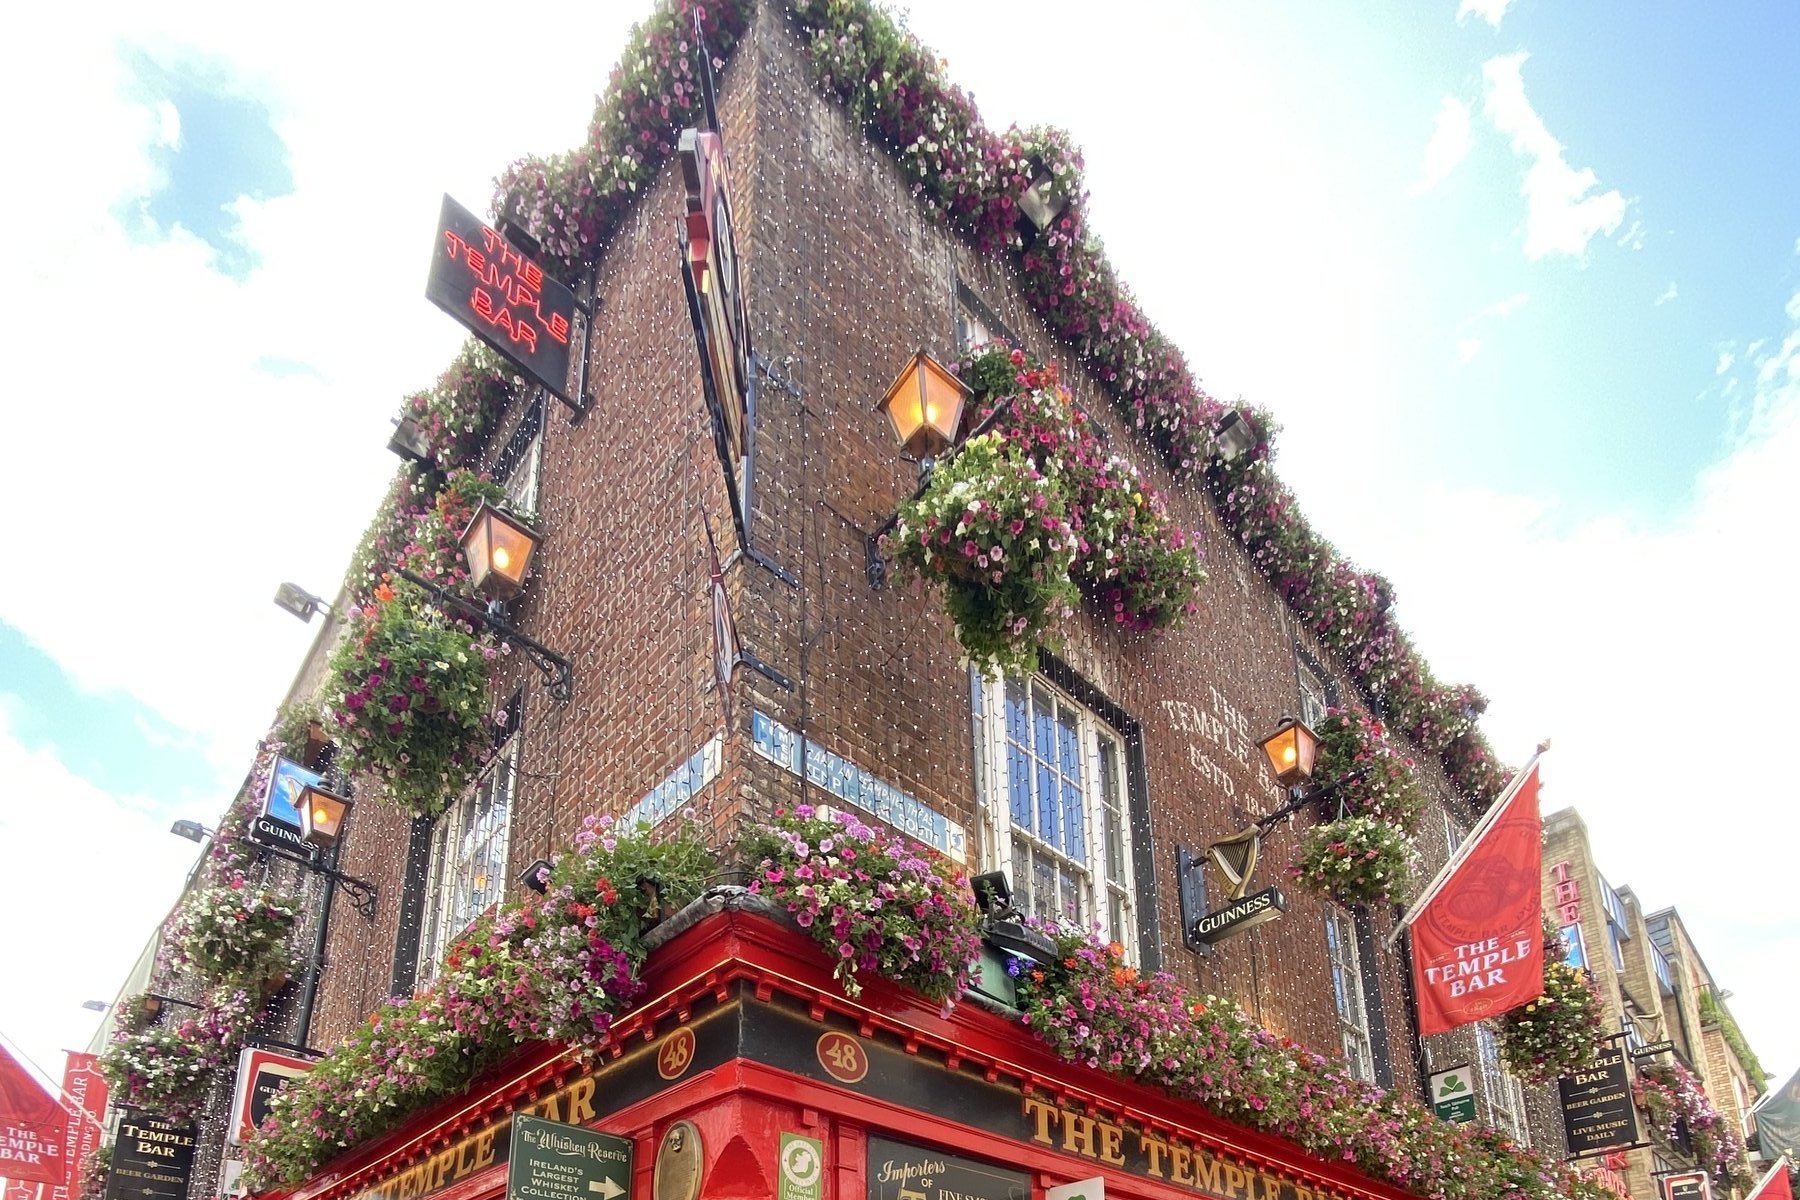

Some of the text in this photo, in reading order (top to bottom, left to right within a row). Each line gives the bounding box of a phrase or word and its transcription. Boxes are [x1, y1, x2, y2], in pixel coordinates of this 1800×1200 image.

[483, 225, 543, 292] THE
[444, 230, 569, 344] TEMPLE
[471, 287, 537, 353] BAR
[1199, 893, 1270, 934] GUINNESS
[1454, 937, 1500, 959] THE
[1424, 939, 1531, 985] TEMPLE
[1450, 968, 1508, 998] BAR
[663, 1035, 690, 1072] 48
[824, 1038, 858, 1072] 48
[1633, 1042, 1672, 1055] GUINNESS
[1575, 1070, 1610, 1085] BAR
[1566, 1092, 1626, 1110] BEER GARDEN
[6, 1127, 38, 1140] THE
[122, 1124, 194, 1146] TEMPLE
[1025, 1099, 1126, 1167] THE
[1573, 1119, 1628, 1136] LIVE MUSIC
[1586, 1130, 1616, 1142] DAILY
[0, 1136, 59, 1156] EMPLE
[136, 1141, 175, 1157] BAR
[521, 1128, 627, 1164] The Whiskey Reserve
[0, 1149, 40, 1164] BAR
[116, 1168, 184, 1183] BEER GARDEN
[529, 1158, 584, 1176] IRELAND'S
[533, 1169, 580, 1184] LARGEST
[877, 1158, 946, 1188] Importers
[531, 1177, 580, 1193] WHISKEY
[789, 1184, 814, 1195] Official
[921, 1178, 934, 1189] OF
